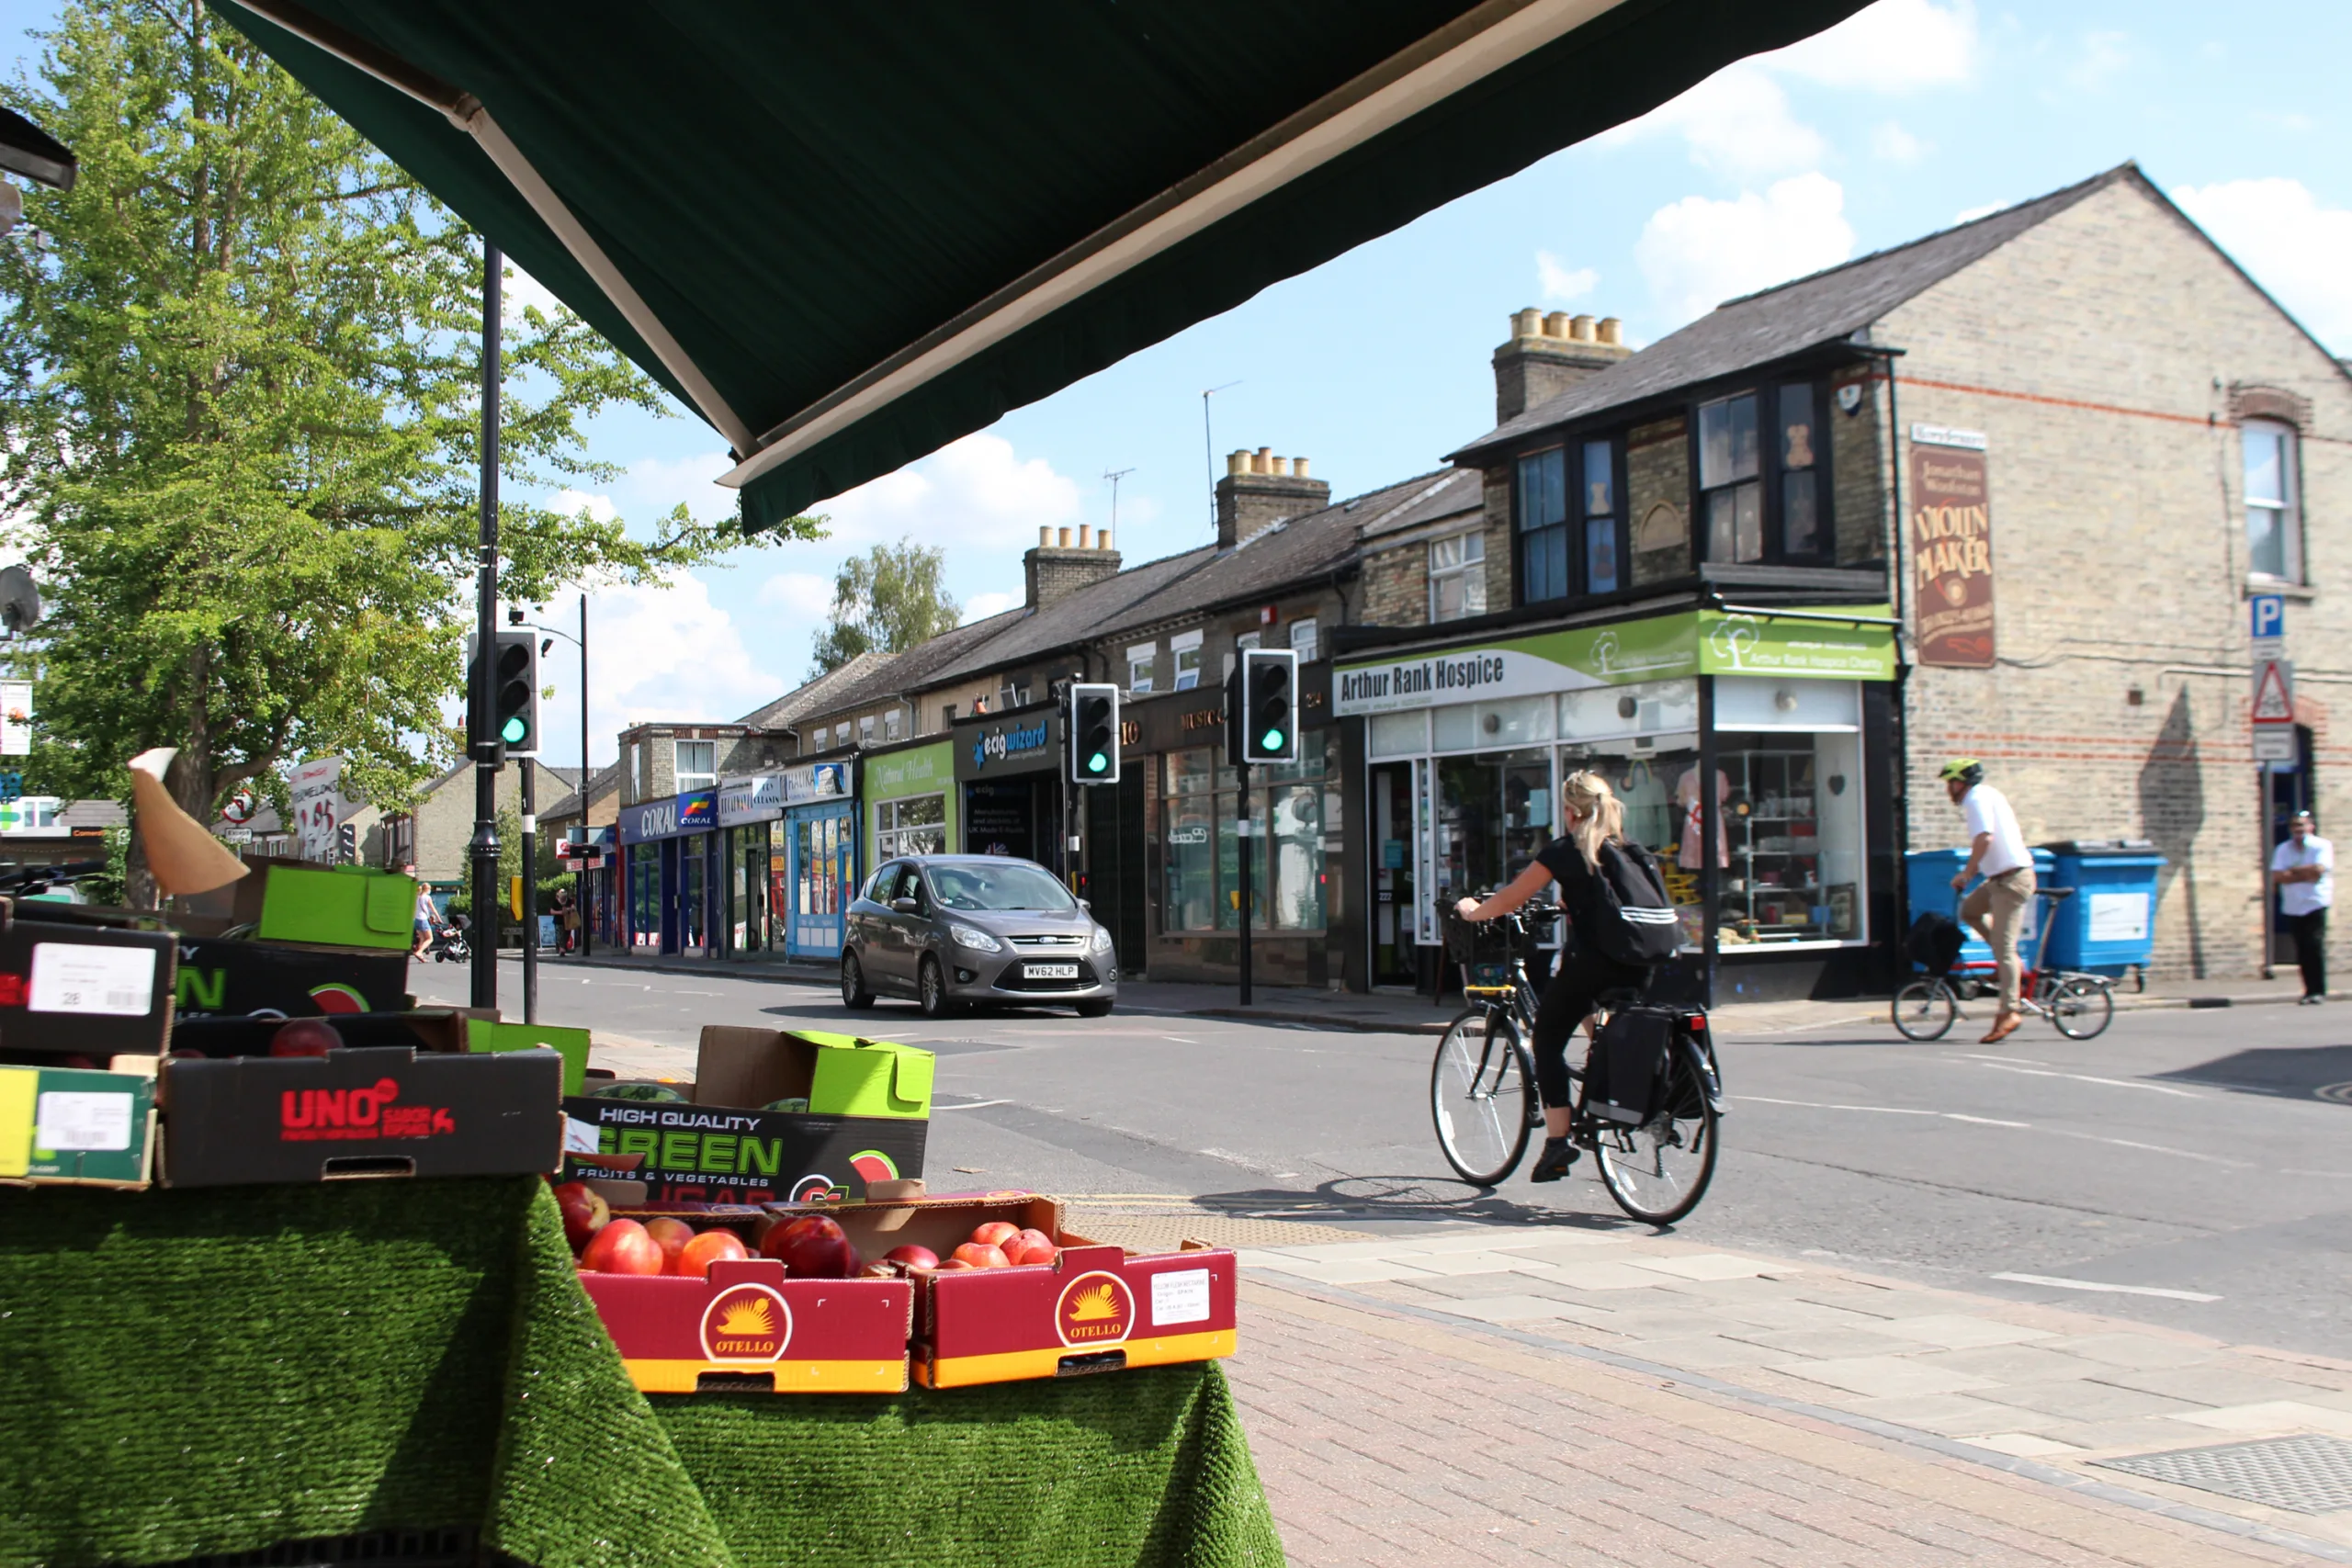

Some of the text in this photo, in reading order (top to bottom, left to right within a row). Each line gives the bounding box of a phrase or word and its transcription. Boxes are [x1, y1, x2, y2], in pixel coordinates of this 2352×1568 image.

[1915, 502, 1988, 542] VIOLIN
[1917, 535, 1992, 592] MAKER
[2257, 599, 2279, 635] P
[1341, 655, 1504, 702] Arthur Rank Hospice
[1180, 711, 1216, 731] MUSIC
[983, 719, 1048, 760] ecigwizard
[642, 804, 677, 838] CORAL
[681, 816, 711, 825] CORAL
[1027, 965, 1074, 976] MV62 HLP
[282, 1088, 379, 1128] UNO
[599, 1108, 761, 1131] HIGH QUALITY
[577, 1168, 769, 1187] FRUITS & VEGETABLES
[1070, 1323, 1121, 1338] OTELLO
[716, 1340, 774, 1353] OTELLO
